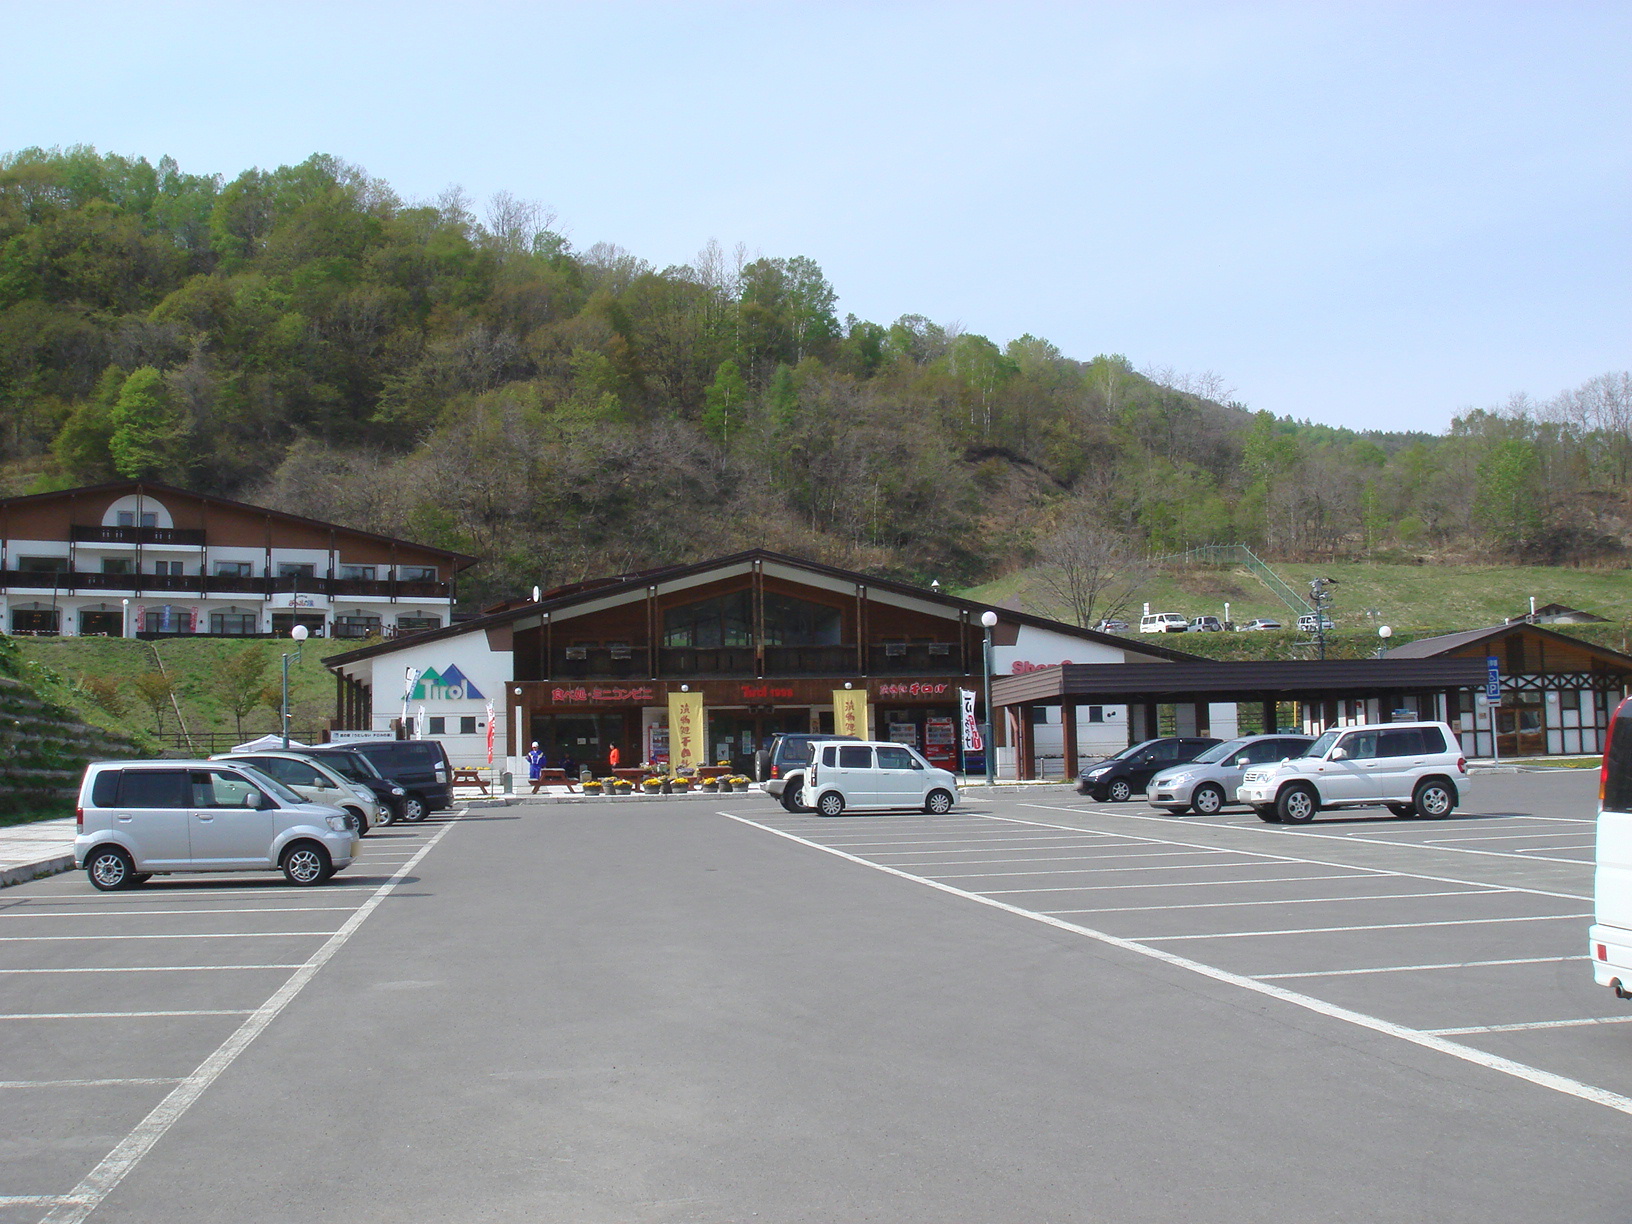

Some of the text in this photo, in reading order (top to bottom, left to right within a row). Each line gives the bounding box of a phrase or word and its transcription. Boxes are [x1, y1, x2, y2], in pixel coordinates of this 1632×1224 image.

[419, 678, 468, 700] Tirol
[551, 687, 653, 701] 食べ処・ミニコンビニ
